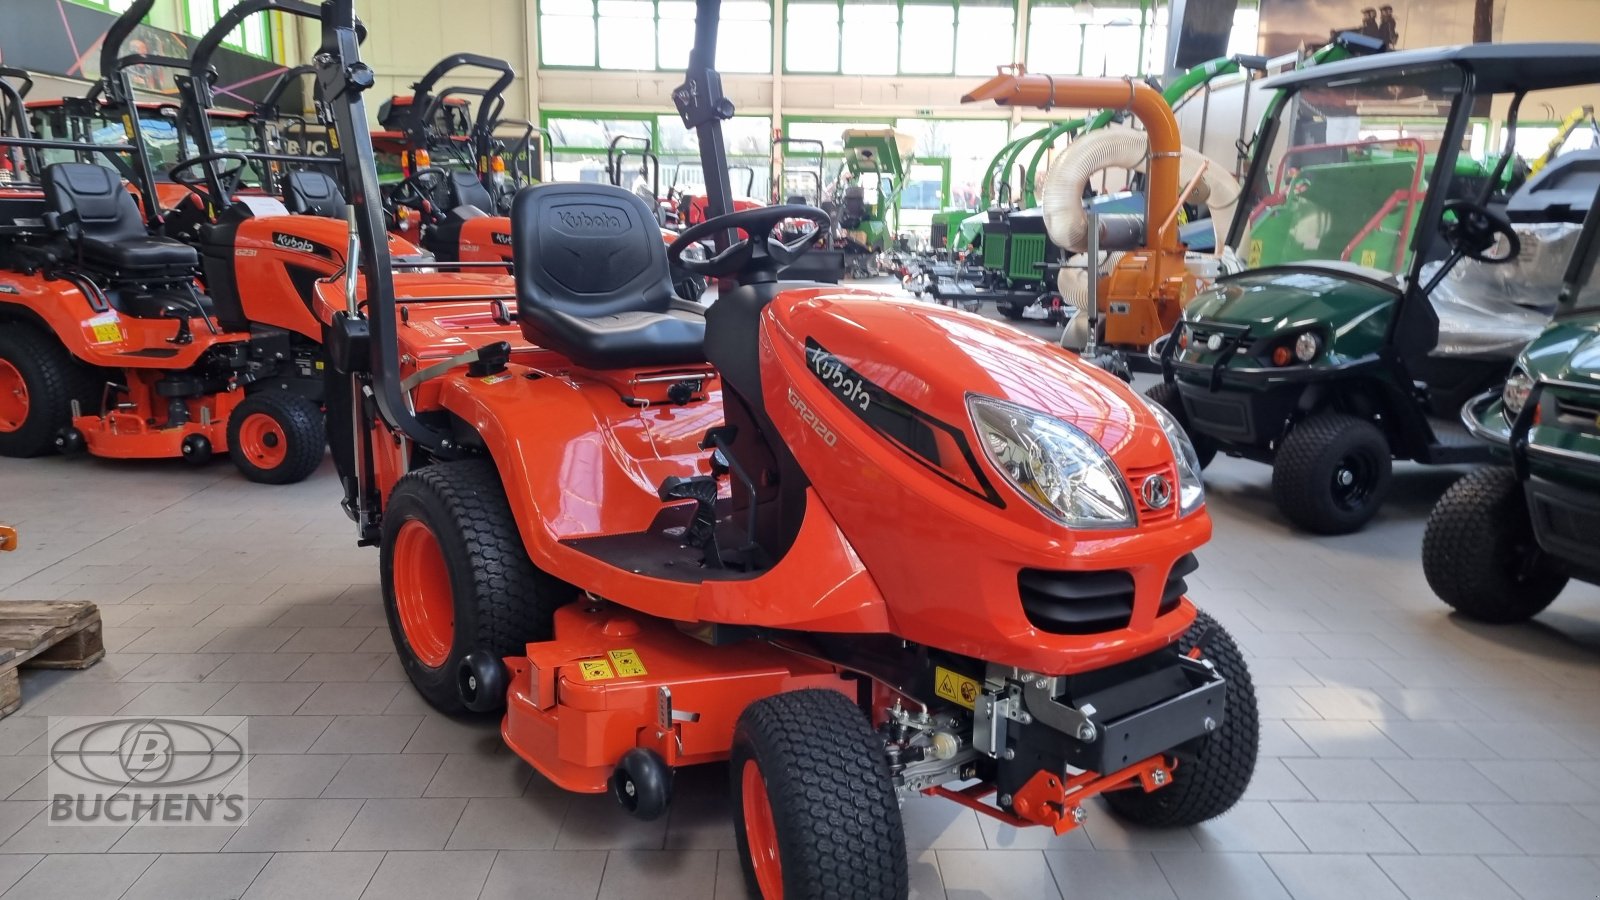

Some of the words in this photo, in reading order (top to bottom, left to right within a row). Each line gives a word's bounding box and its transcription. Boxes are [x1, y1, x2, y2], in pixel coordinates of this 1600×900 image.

[557, 211, 620, 229] Kubota
[277, 234, 313, 252] Kubota
[811, 347, 870, 411] Kubota
[788, 386, 837, 448] GR2120
